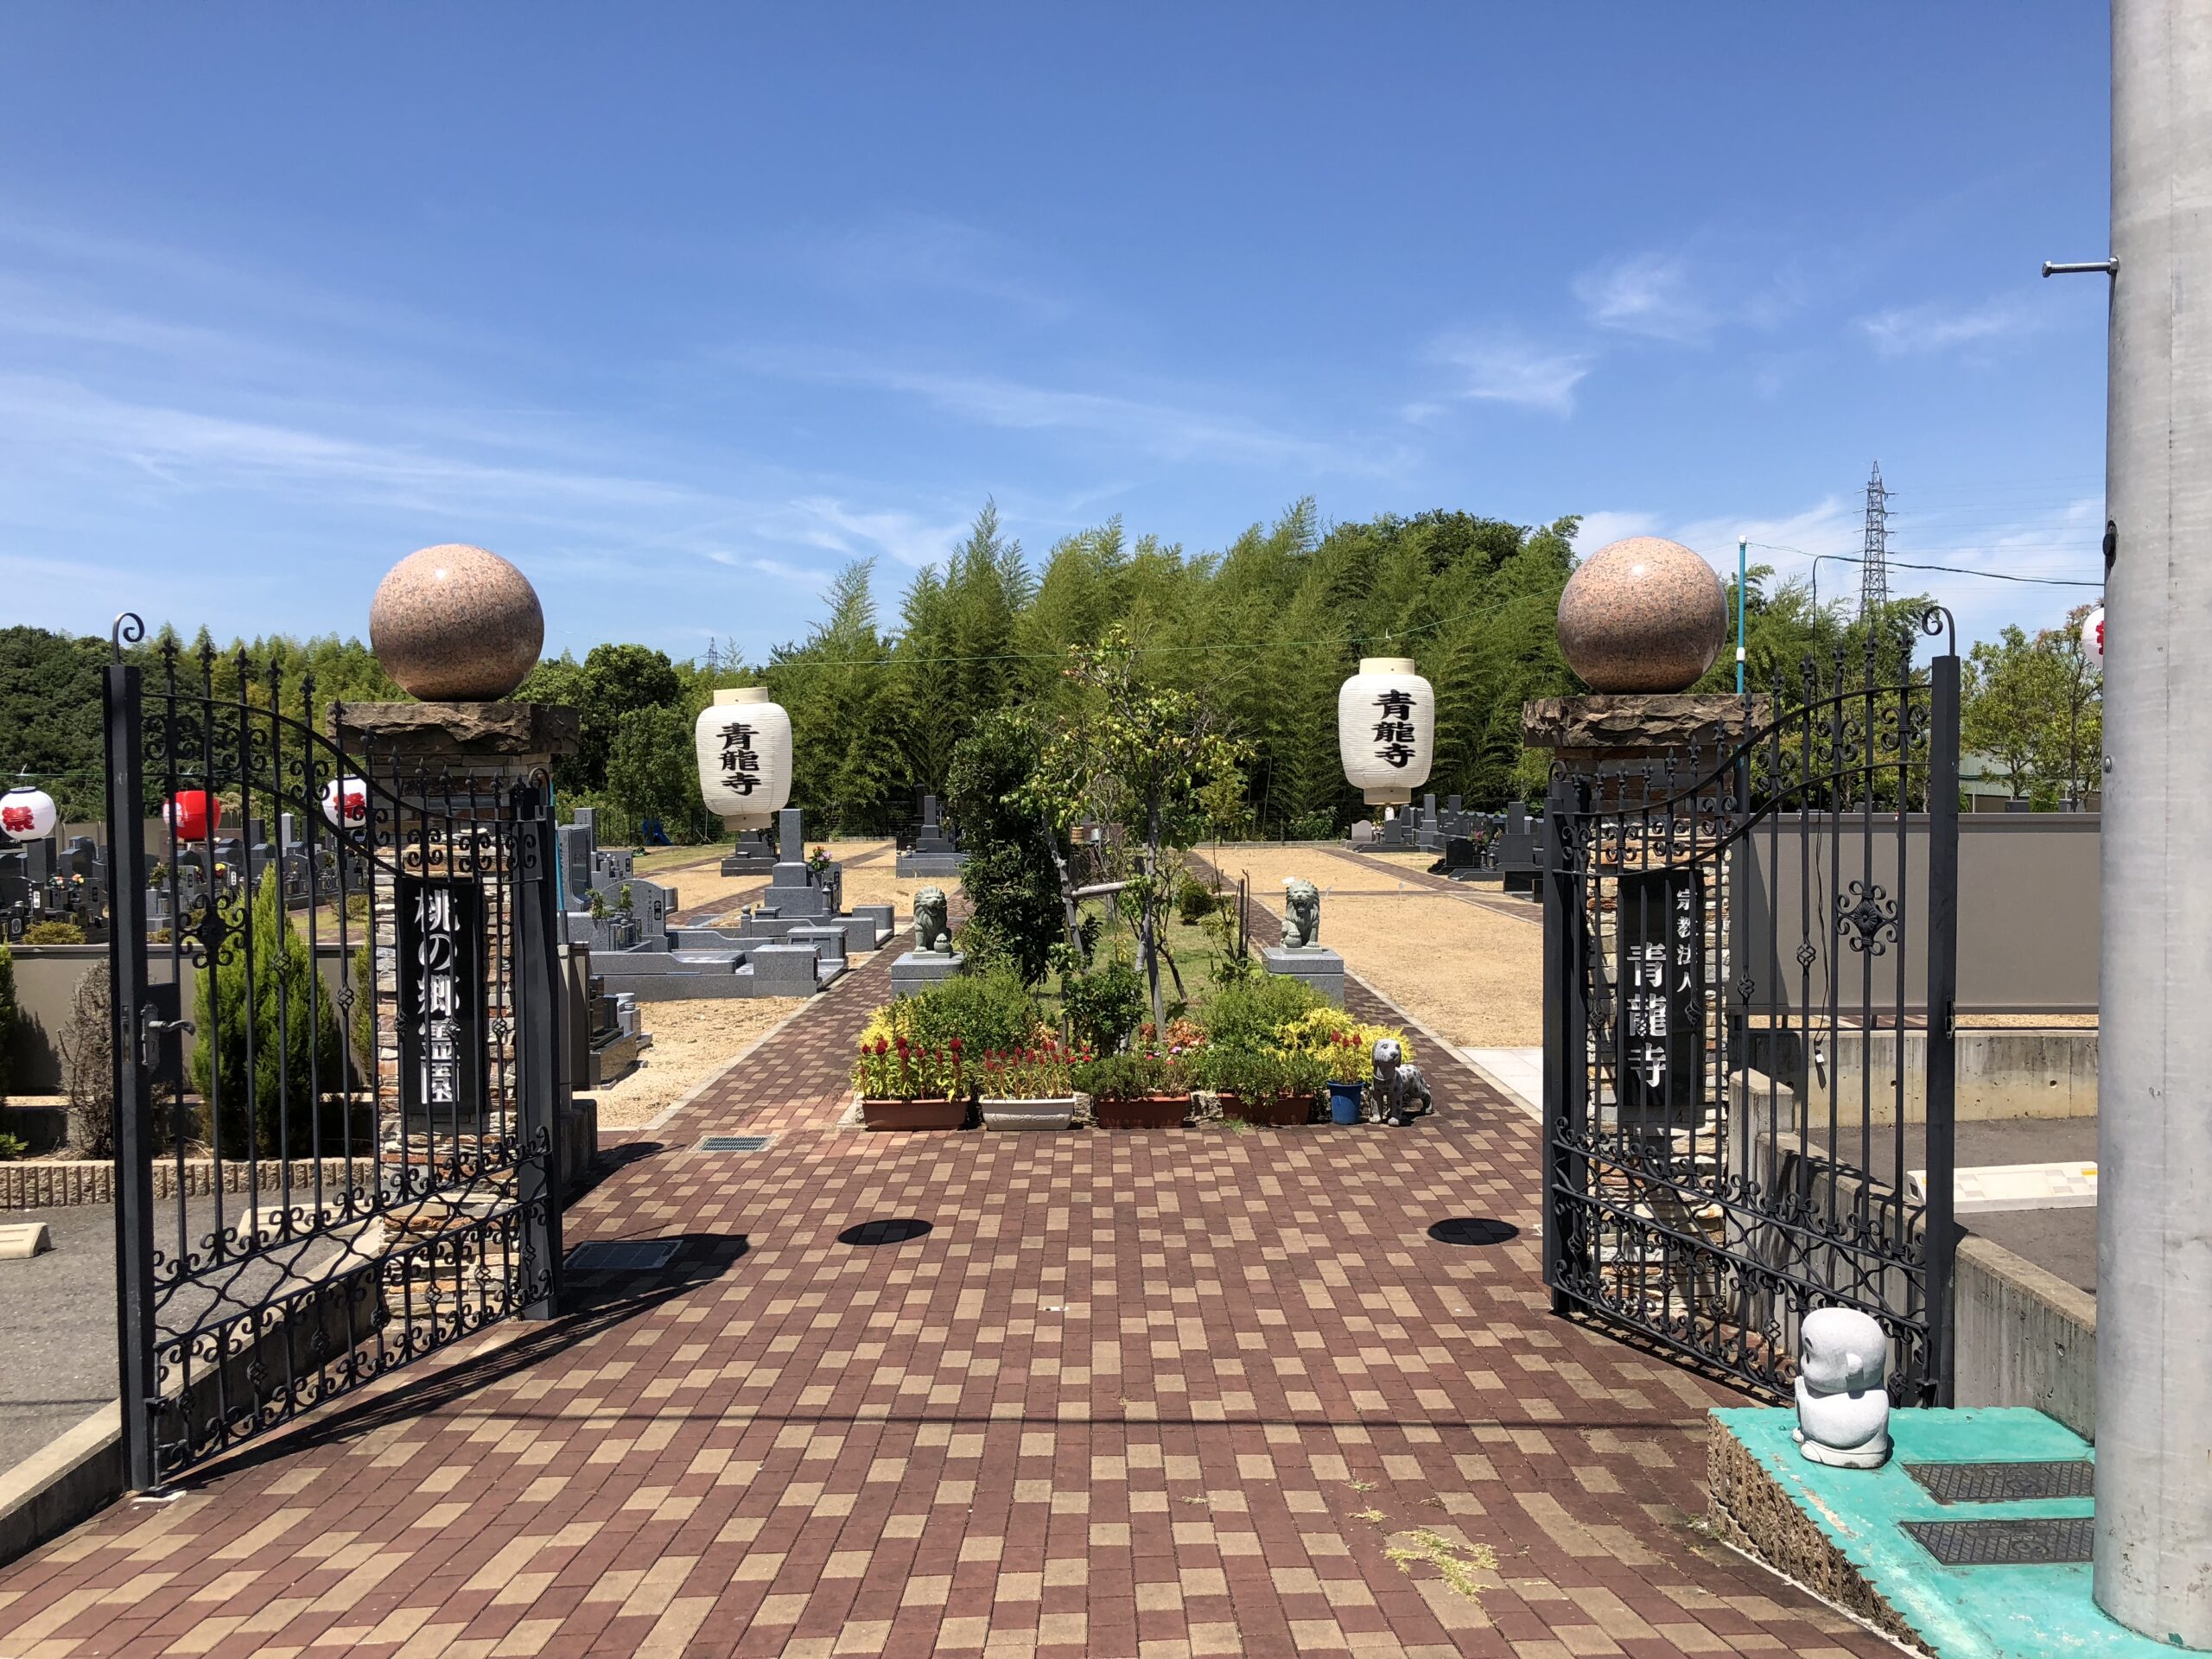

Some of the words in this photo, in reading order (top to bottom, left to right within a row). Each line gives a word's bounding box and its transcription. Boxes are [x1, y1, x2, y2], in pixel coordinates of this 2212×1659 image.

[715, 721, 762, 796] 青龍寺
[1370, 689, 1417, 768] 青龍寺
[1676, 887, 1699, 993] 宗教法人
[414, 887, 461, 1104] 桃の郷霊園
[1626, 942, 1667, 1088] 青龍寺
